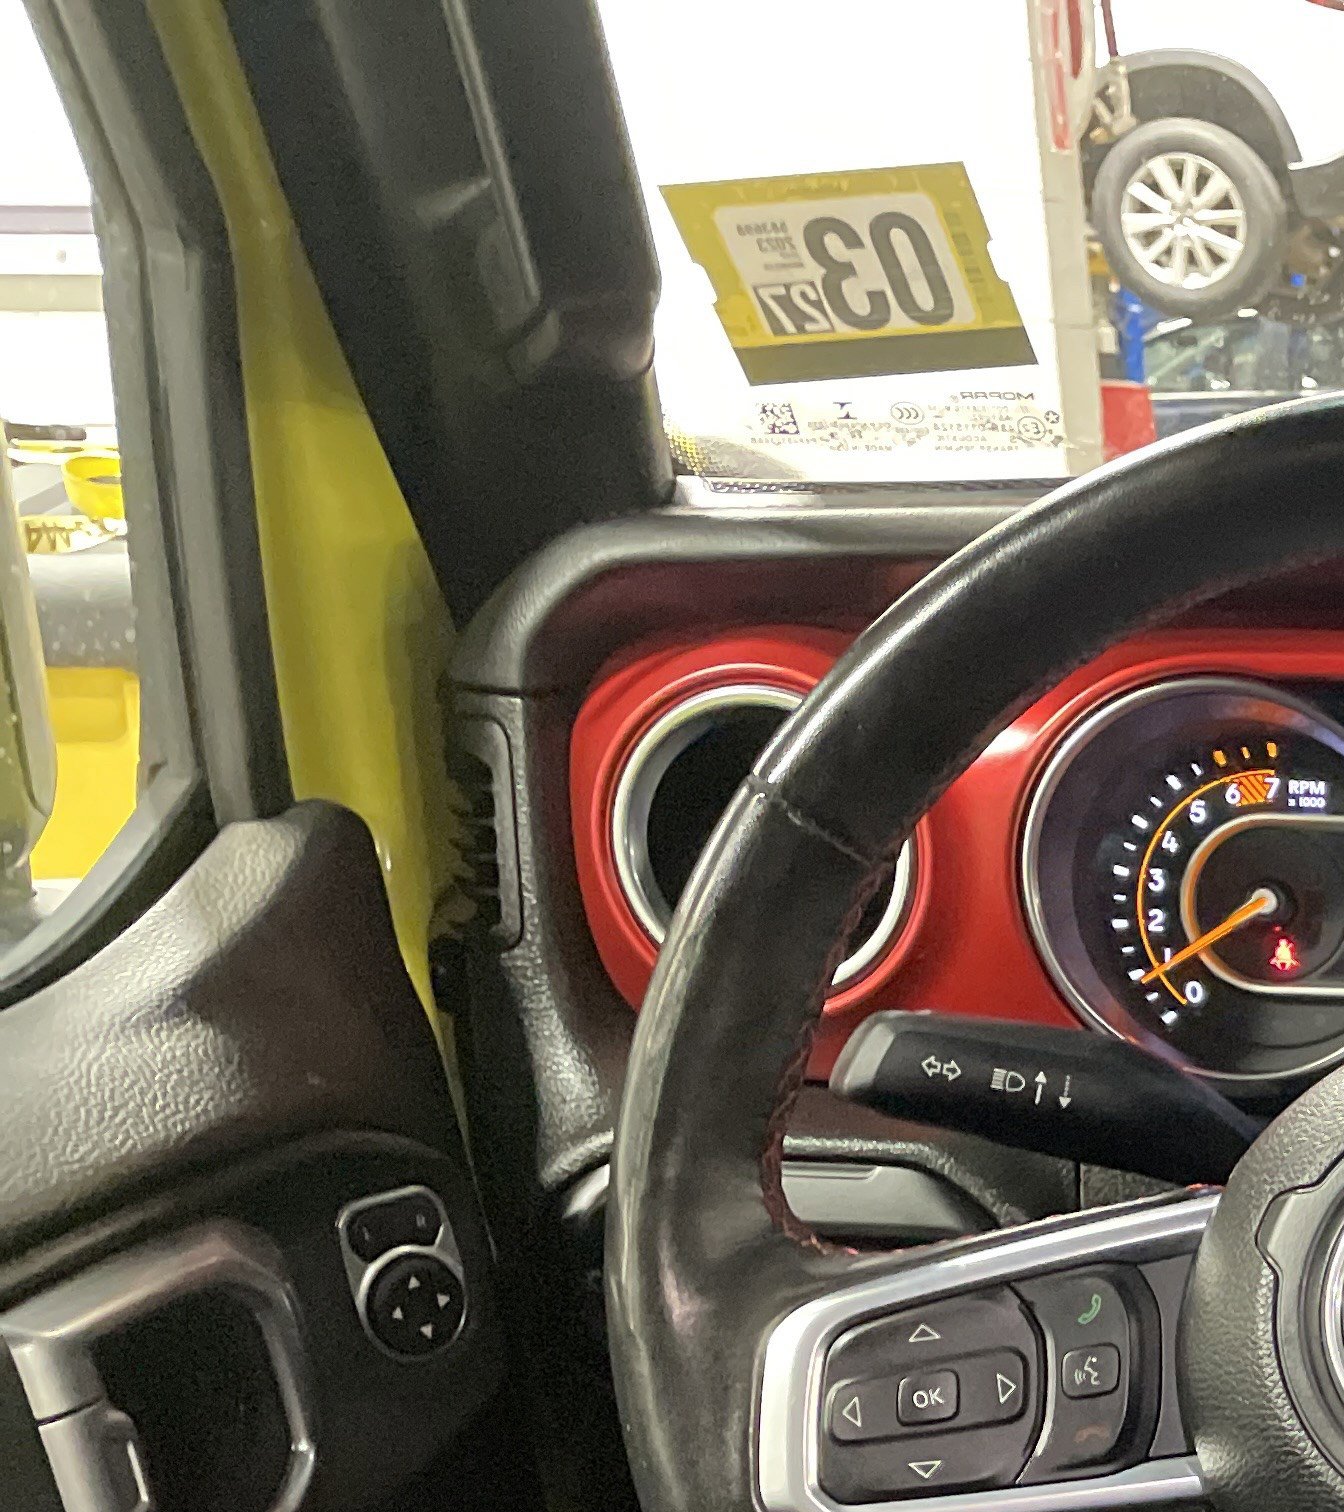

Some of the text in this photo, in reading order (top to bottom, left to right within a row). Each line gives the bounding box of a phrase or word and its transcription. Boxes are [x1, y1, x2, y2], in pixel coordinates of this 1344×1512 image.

[1225, 784, 1240, 805] 6
[1264, 778, 1280, 799] 7
[1288, 779, 1326, 796] RPM
[1189, 800, 1206, 823] 5
[1161, 832, 1179, 853] 4
[1148, 867, 1165, 892] 3
[1148, 909, 1165, 932] 2
[1185, 980, 1204, 1004] 0
[912, 1387, 944, 1409] OK
